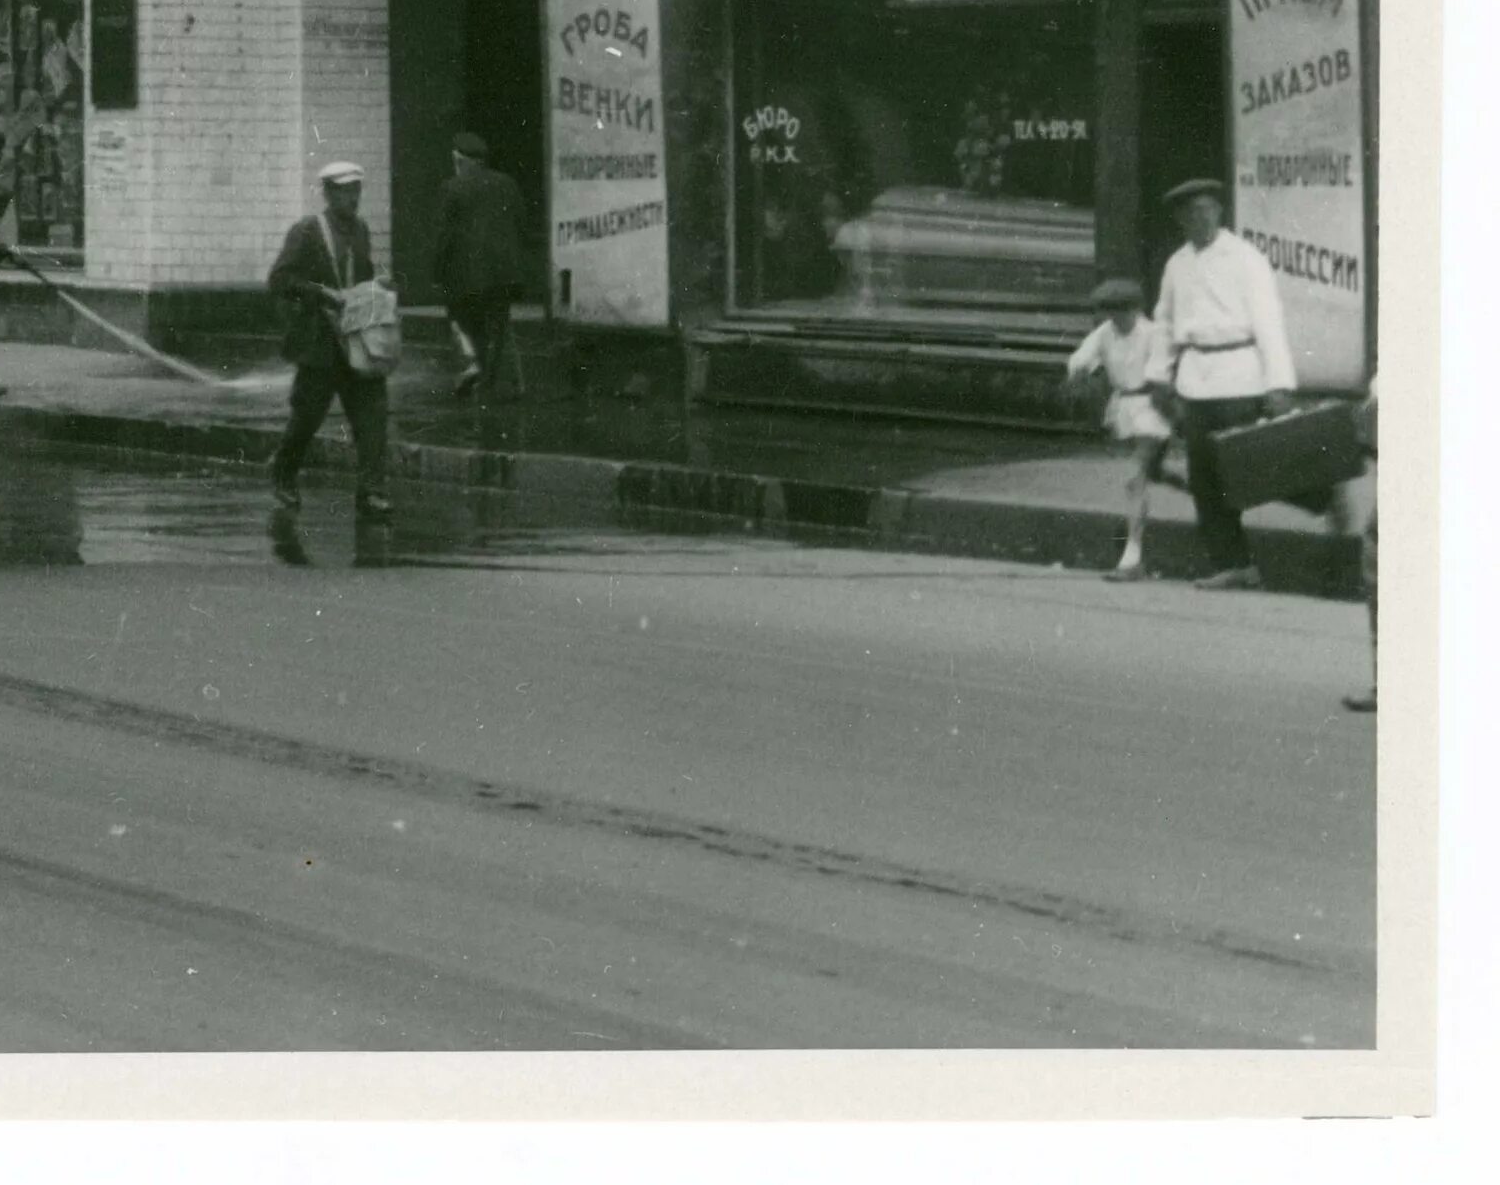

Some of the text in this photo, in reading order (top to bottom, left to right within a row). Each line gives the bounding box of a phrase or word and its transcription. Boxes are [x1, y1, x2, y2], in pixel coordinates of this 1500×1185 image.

[560, 8, 649, 58] ГРОБА
[558, 76, 655, 135] ВЕНКИ
[1241, 49, 1351, 115] ЗАКАЗОВ
[743, 105, 800, 140] БЮРО
